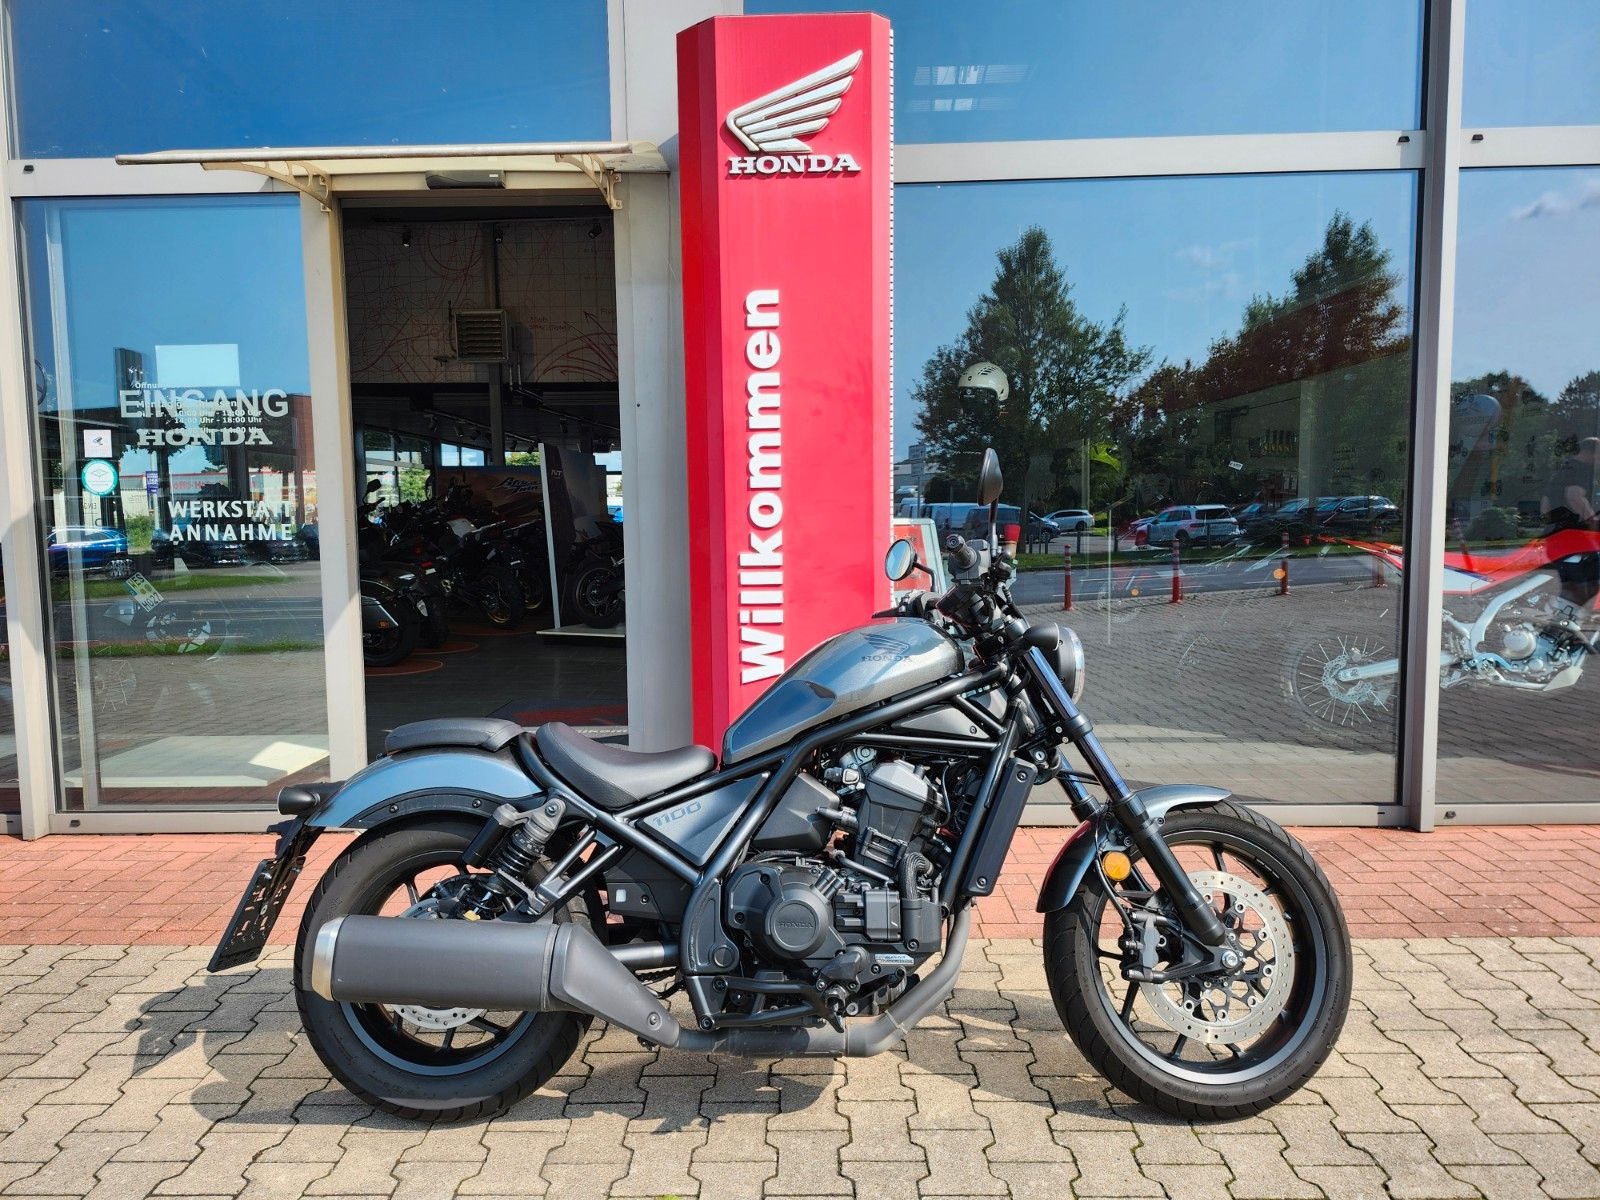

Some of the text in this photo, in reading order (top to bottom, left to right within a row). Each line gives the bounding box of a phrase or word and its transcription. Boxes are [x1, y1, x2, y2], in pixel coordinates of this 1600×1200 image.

[728, 153, 861, 174] HONDA
[119, 388, 289, 419] EINGANG
[222, 416, 245, 424] 18:00
[136, 428, 273, 446] HONDA
[739, 289, 785, 685] Willkommen
[167, 500, 292, 518] WERKSTATT
[168, 523, 293, 542] ANNAHME
[861, 654, 912, 662] HONDA
[652, 801, 702, 827] 1100
[778, 920, 815, 929] HONDA
